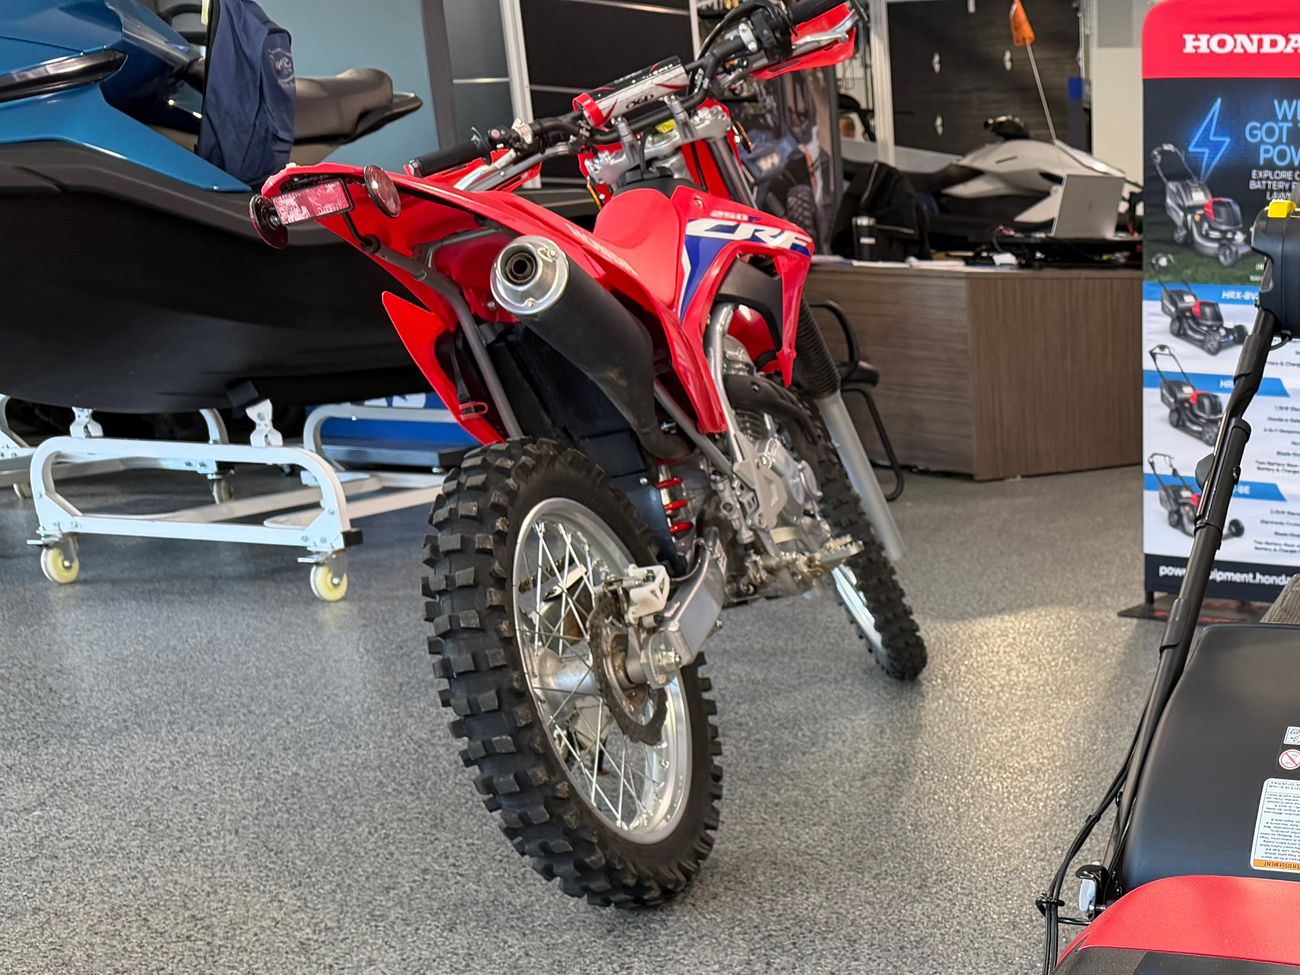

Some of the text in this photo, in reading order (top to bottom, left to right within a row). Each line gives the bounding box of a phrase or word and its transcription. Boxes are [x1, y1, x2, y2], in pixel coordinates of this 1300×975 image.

[1245, 121, 1292, 143] GOT
[1251, 169, 1292, 180] EXPLORE
[1249, 180, 1291, 190] BATTERY
[684, 217, 814, 250] CRF
